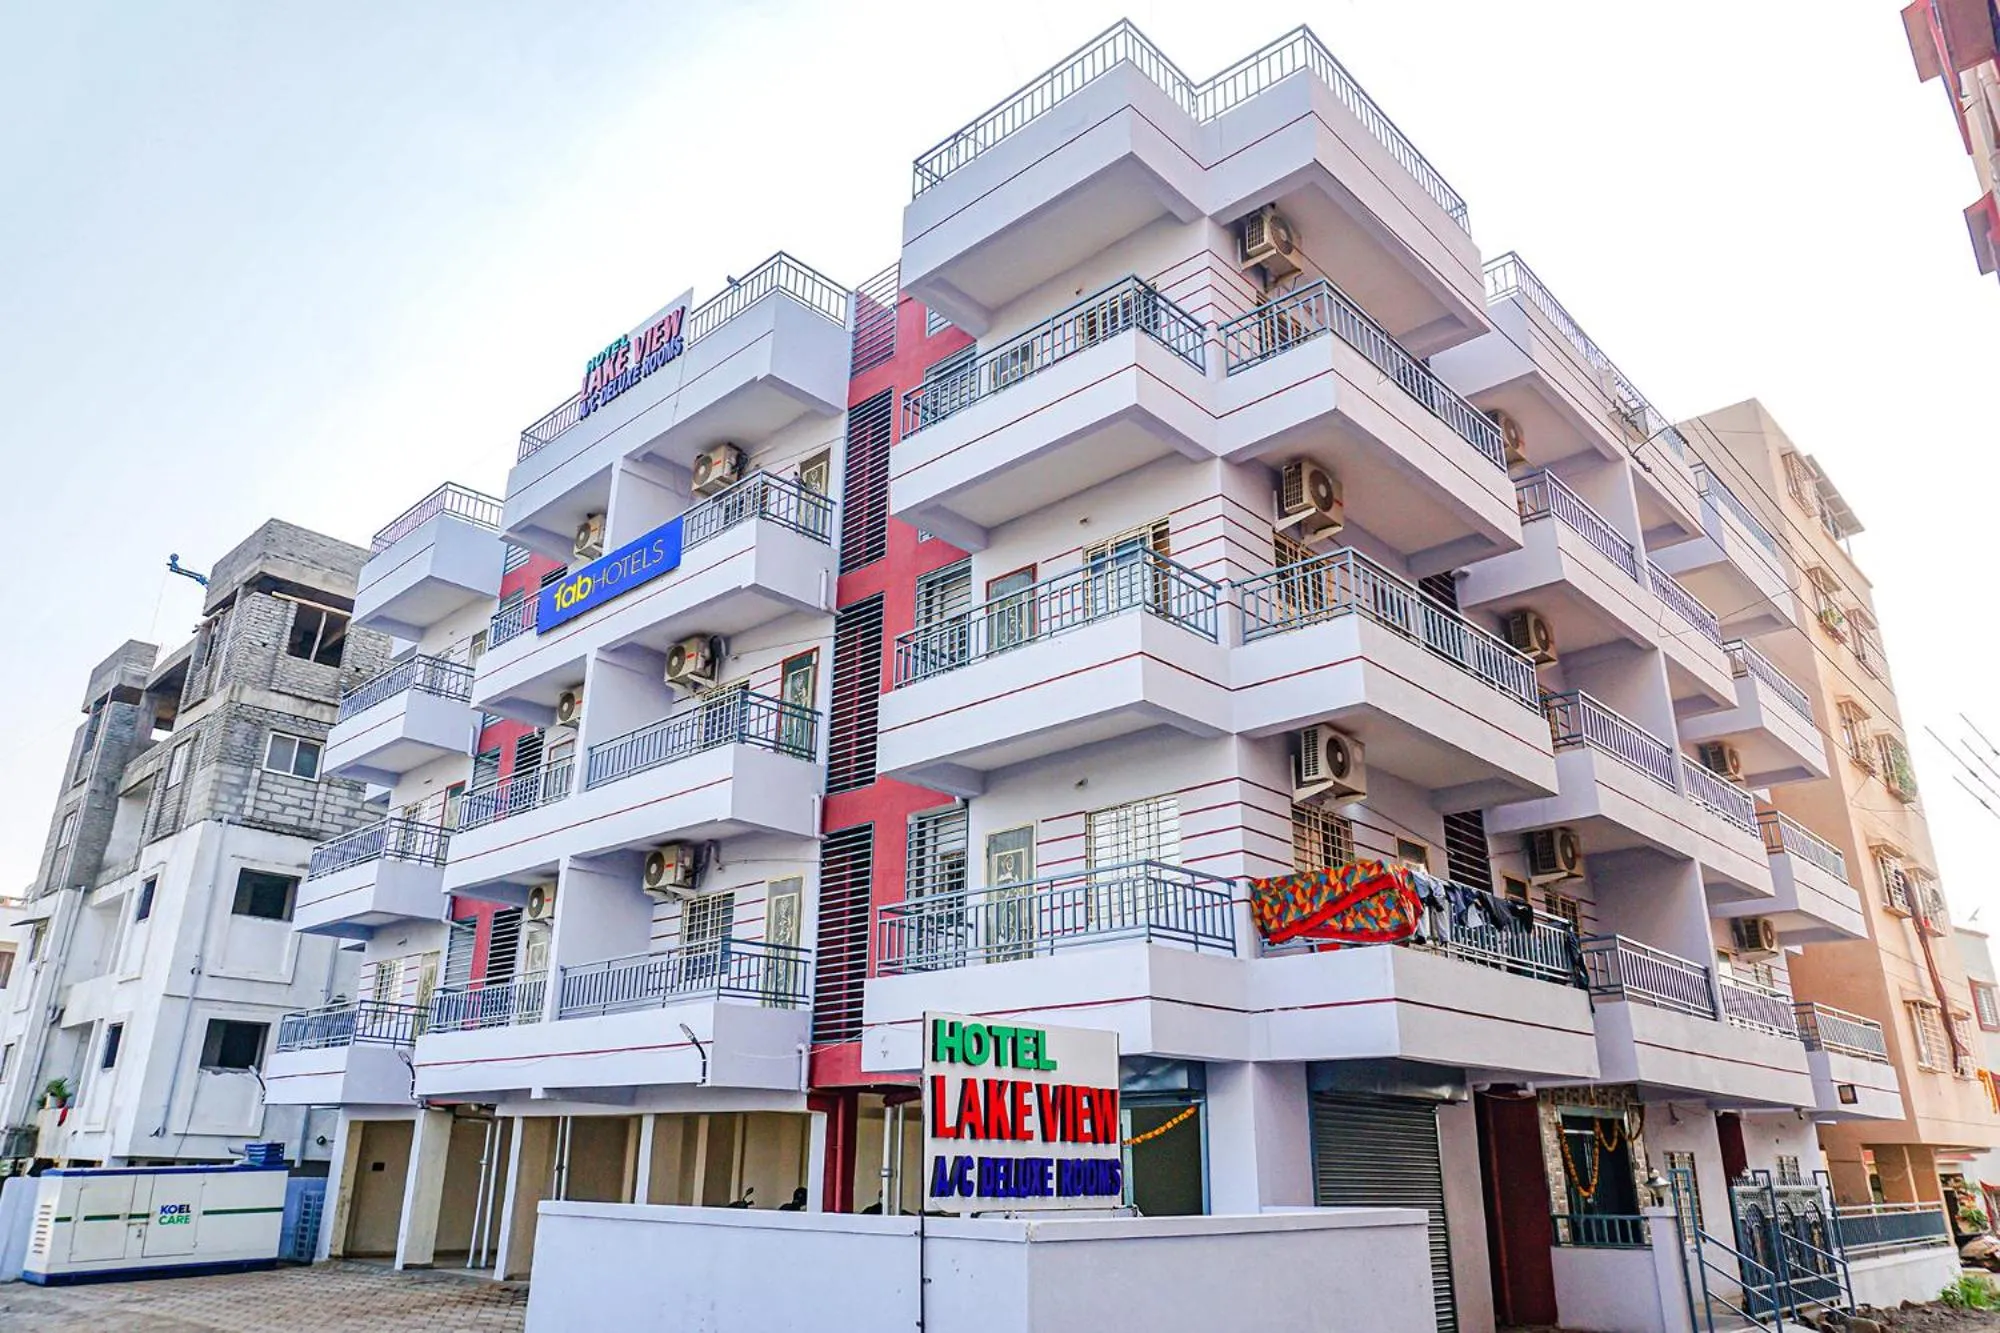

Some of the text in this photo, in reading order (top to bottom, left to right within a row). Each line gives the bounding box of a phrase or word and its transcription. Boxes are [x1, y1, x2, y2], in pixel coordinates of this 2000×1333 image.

[580, 306, 686, 400] LAKE VIEW
[587, 334, 629, 374] HOTEL
[600, 365, 643, 407] DELUXE
[643, 336, 685, 378] ROOMS
[932, 1019, 1057, 1070] HOTEL
[931, 1075, 1118, 1144] LAKE VIEW
[930, 1155, 1123, 1198] A/C DELUXE ROOMS
[159, 1215, 191, 1225] CARE
[160, 1204, 191, 1214] KOEL
